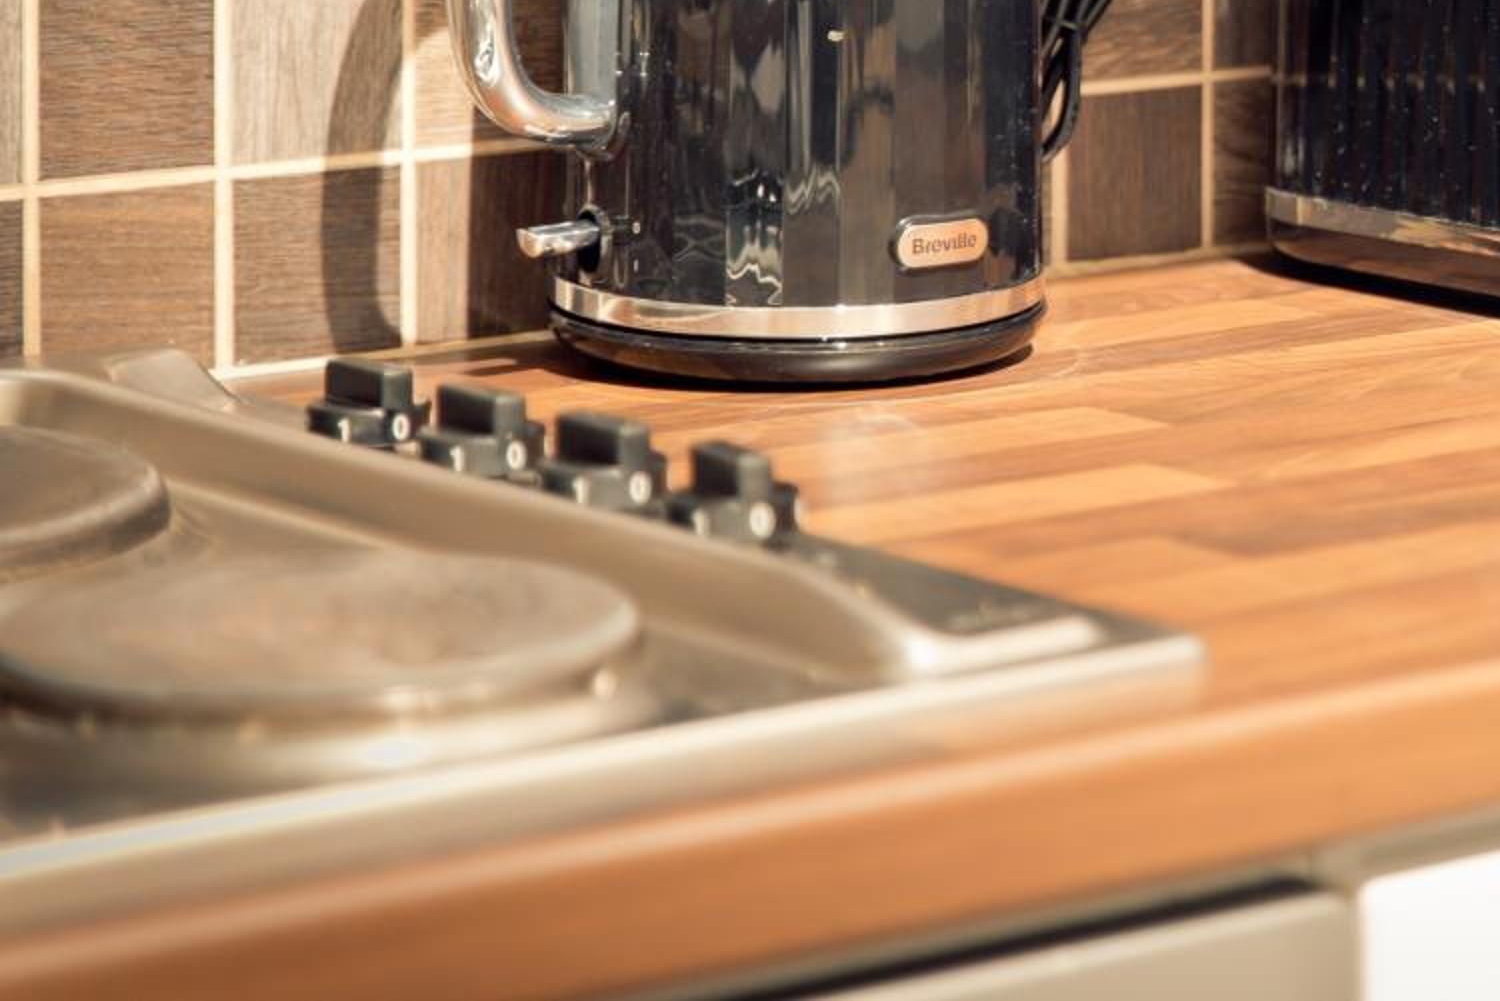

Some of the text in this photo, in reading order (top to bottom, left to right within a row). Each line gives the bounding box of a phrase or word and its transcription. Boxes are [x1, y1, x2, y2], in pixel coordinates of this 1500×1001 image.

[911, 232, 977, 255] Breville
[338, 413, 410, 443] 1 0
[451, 440, 527, 472] 1 0
